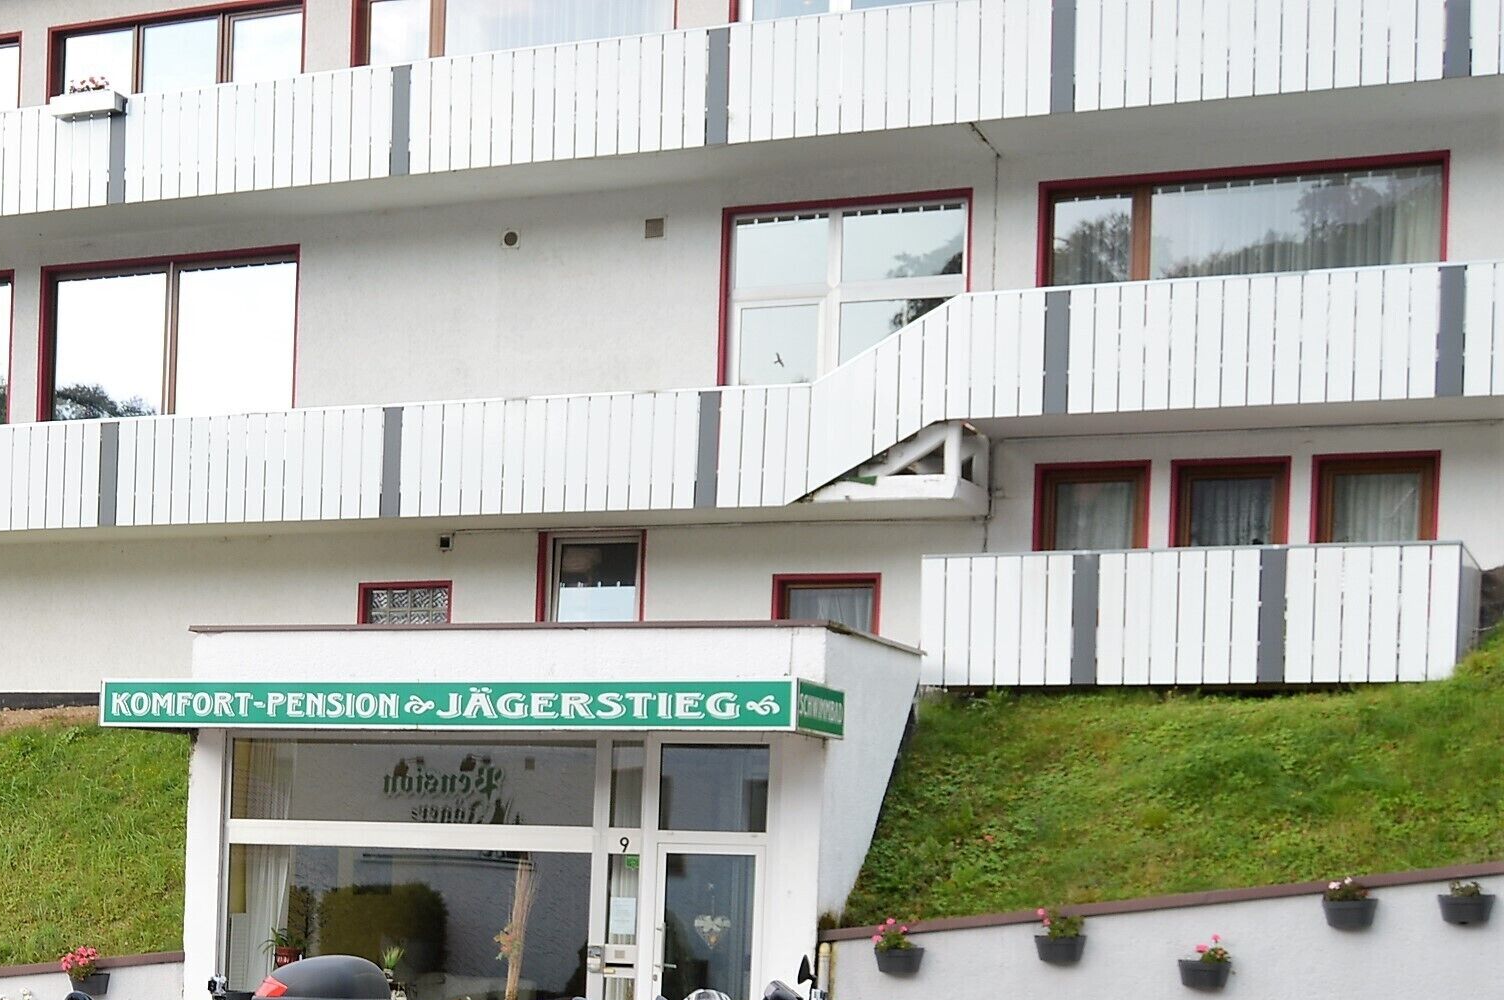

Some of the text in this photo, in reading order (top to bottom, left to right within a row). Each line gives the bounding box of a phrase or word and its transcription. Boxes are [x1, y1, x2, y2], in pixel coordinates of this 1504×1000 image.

[110, 687, 742, 720] KOMFORT-PENSION JÄGERSTIEG
[619, 837, 630, 853] 9
